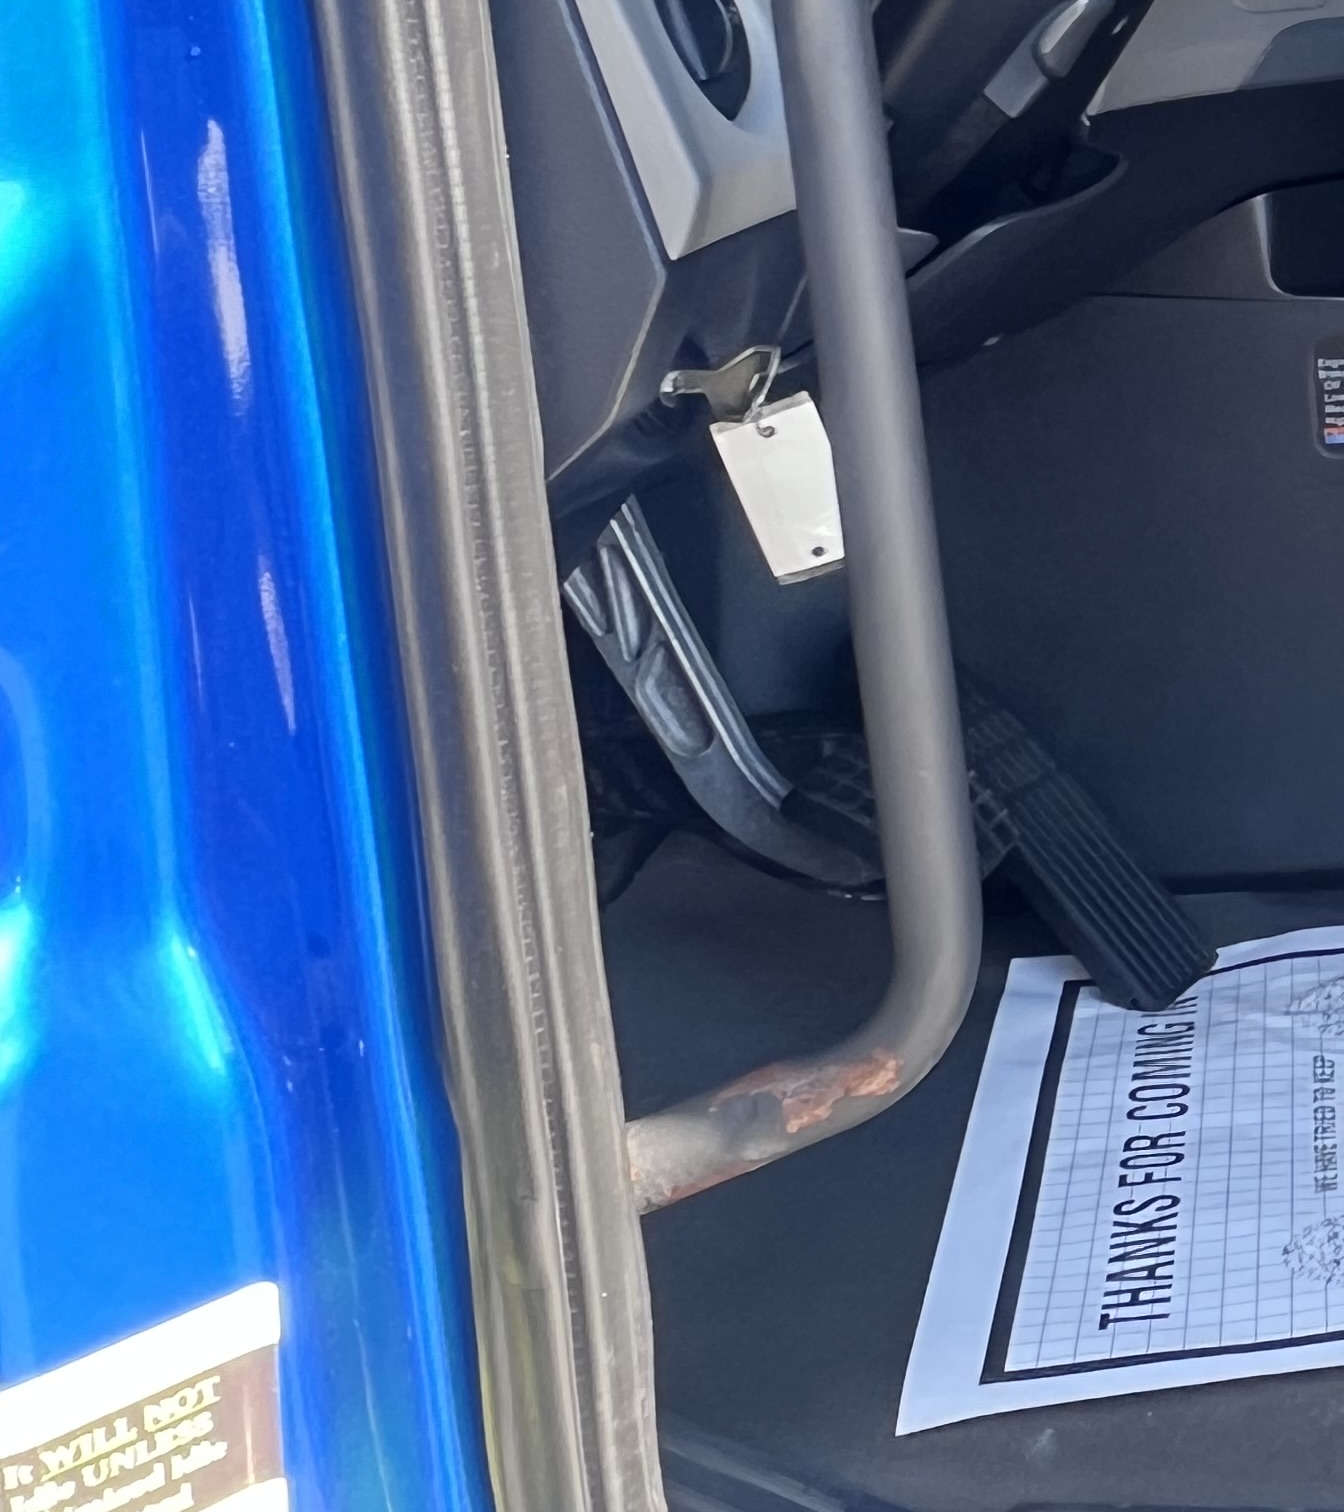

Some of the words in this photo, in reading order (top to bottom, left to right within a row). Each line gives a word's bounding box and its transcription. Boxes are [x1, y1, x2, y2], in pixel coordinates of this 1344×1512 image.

[1126, 1020, 1196, 1121] COMING
[1118, 1130, 1187, 1189] FOR
[1098, 1193, 1181, 1331] THANKS
[38, 1416, 138, 1483] WILL
[143, 1375, 221, 1433] NOT
[80, 1410, 214, 1487] UNLESS
